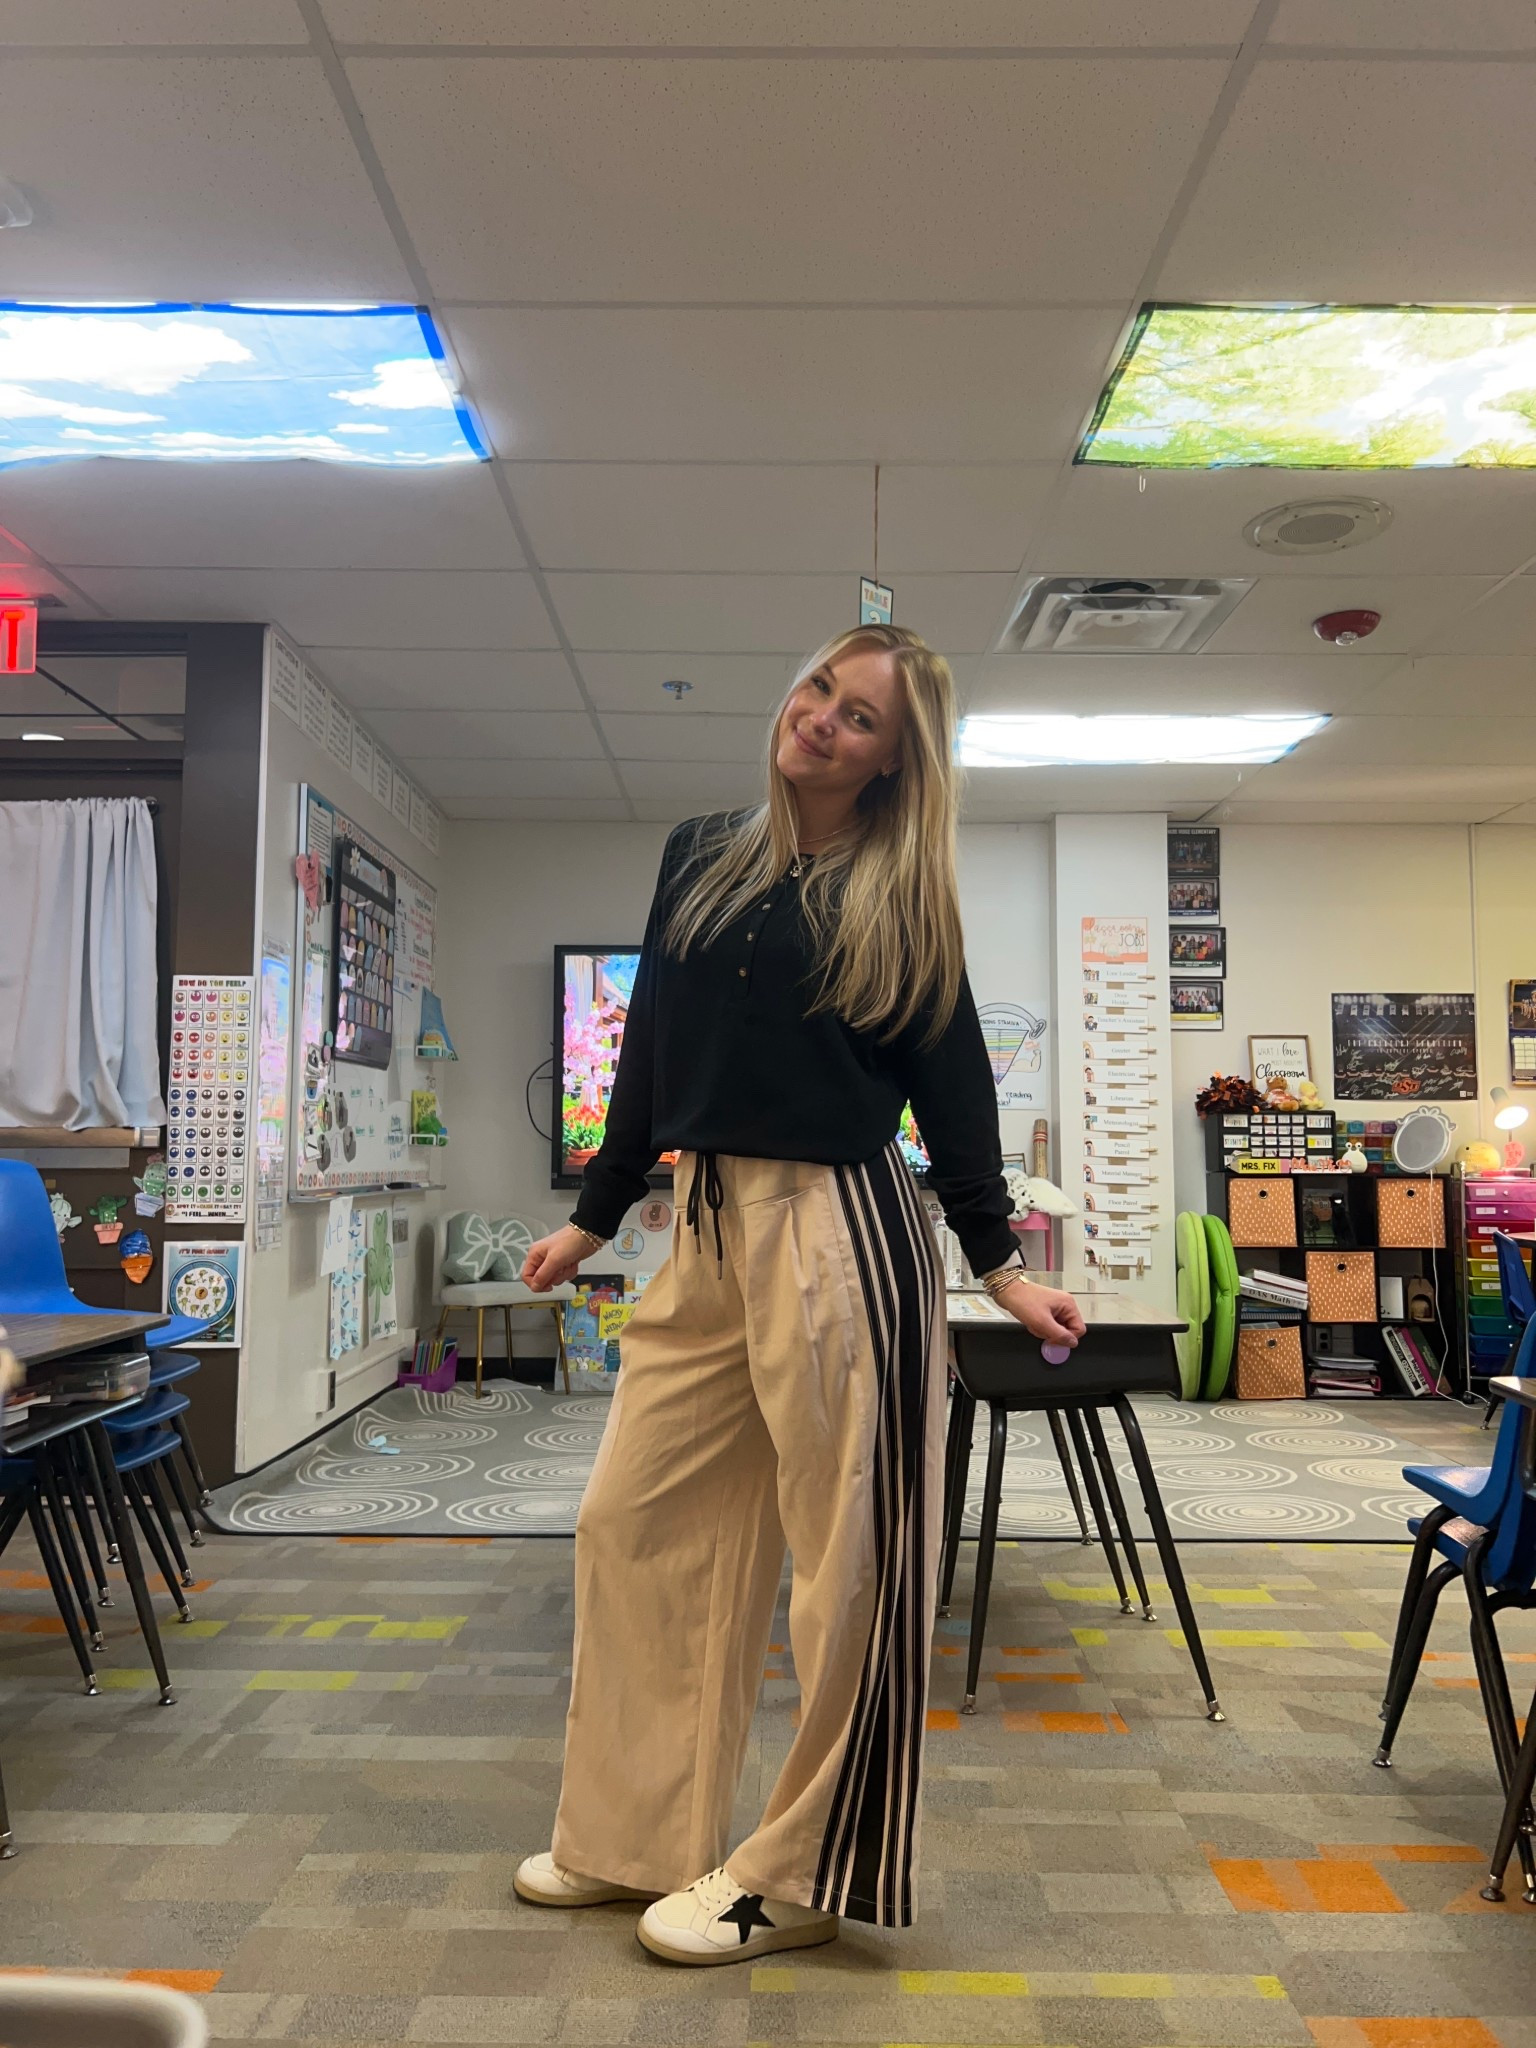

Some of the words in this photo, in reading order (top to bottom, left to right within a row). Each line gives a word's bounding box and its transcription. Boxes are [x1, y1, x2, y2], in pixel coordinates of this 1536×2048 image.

[1119, 933, 1146, 947] JOBS
[1258, 1048, 1274, 1056] WHAT
[1282, 1042, 1299, 1056] love
[1256, 1063, 1306, 1079] Classroom
[1006, 1091, 1032, 1101] reading
[1103, 1119, 1139, 1127] Meteorologist
[925, 1203, 942, 1212] VEL
[589, 1298, 610, 1309] LOR
[1270, 1293, 1291, 1304] Math
[603, 1309, 623, 1321] WACKY
[1401, 1359, 1416, 1382] GUIDED
